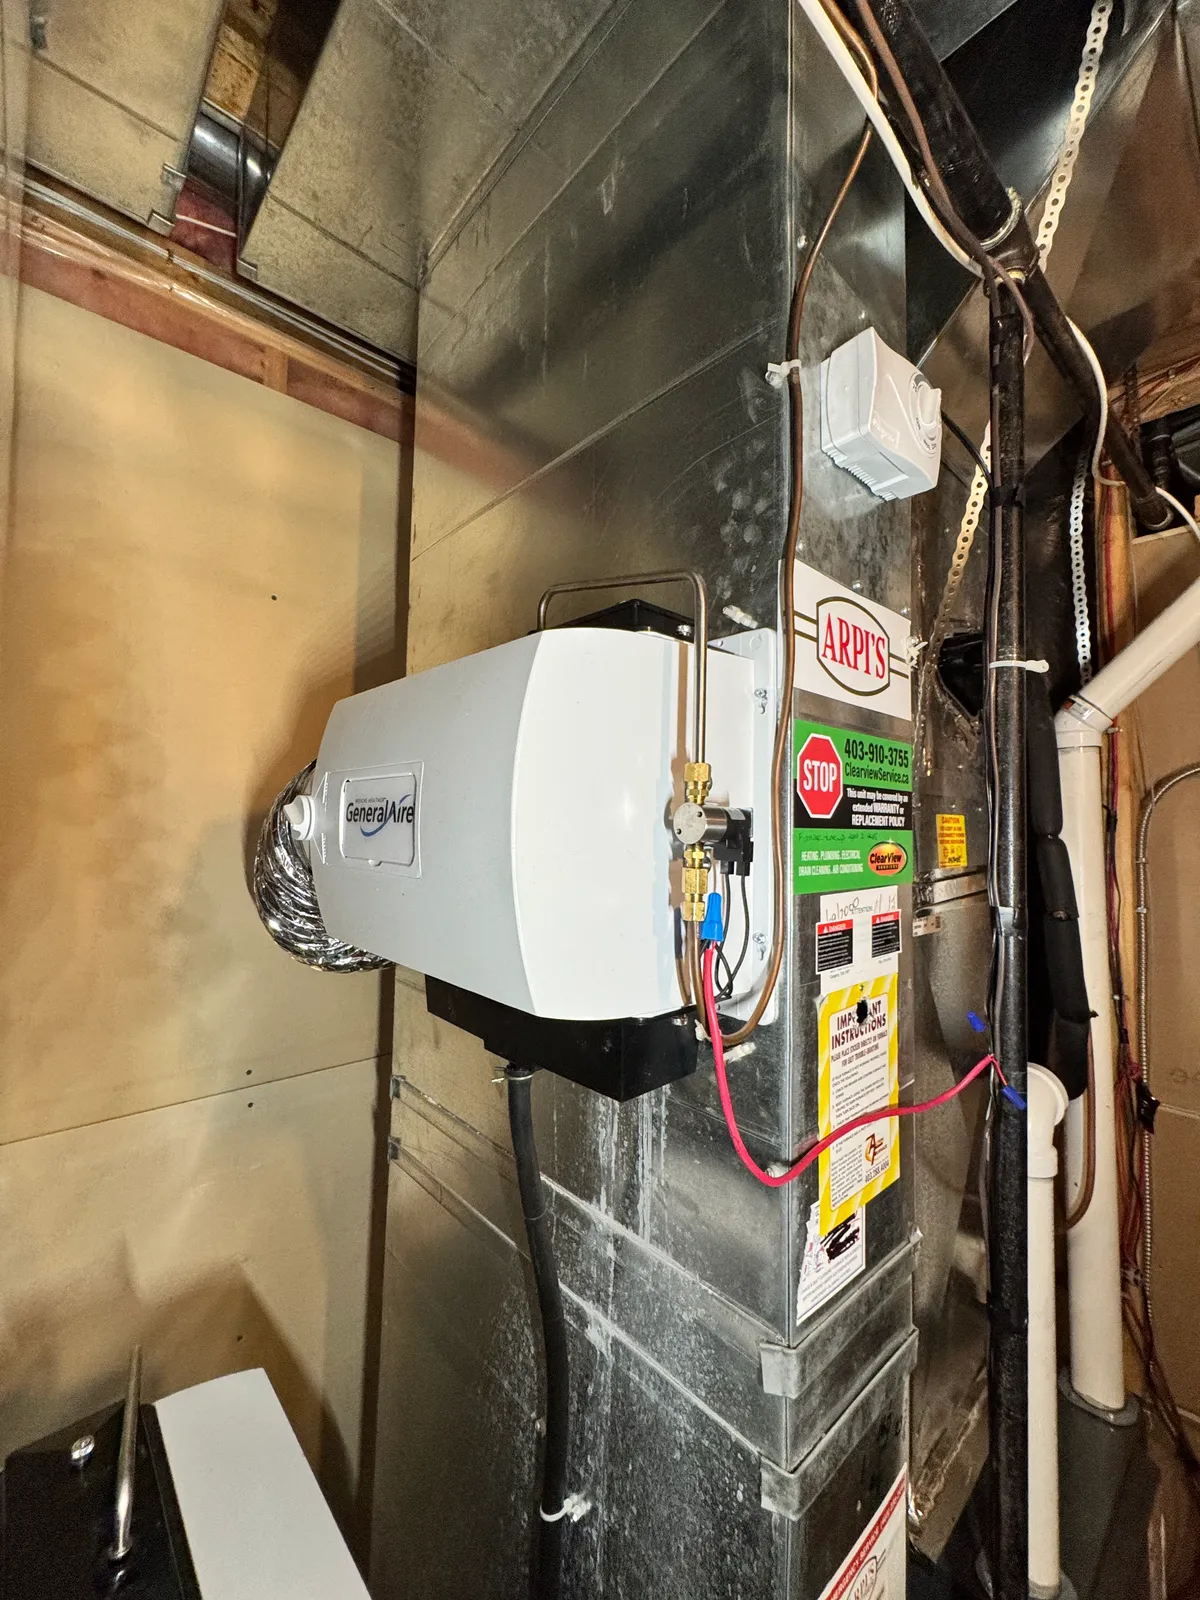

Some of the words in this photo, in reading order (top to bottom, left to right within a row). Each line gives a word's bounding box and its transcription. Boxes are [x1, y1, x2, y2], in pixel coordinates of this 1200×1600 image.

[822, 613, 885, 679] ARPI'S
[844, 738, 909, 768] 403-910-3755
[803, 759, 837, 793] STOP
[844, 764, 909, 784] ClearviewService.ca
[847, 788, 857, 797] This
[876, 790, 882, 800] be
[346, 800, 414, 823] GeneralAire
[852, 803, 873, 813] extended
[873, 803, 899, 814] WARRANTY
[852, 814, 888, 826] REPLACEMENT
[888, 816, 905, 827] POLICY
[870, 852, 902, 864] ClearView
[828, 923, 847, 932] DANGER
[837, 1000, 882, 1031] IMPNT
